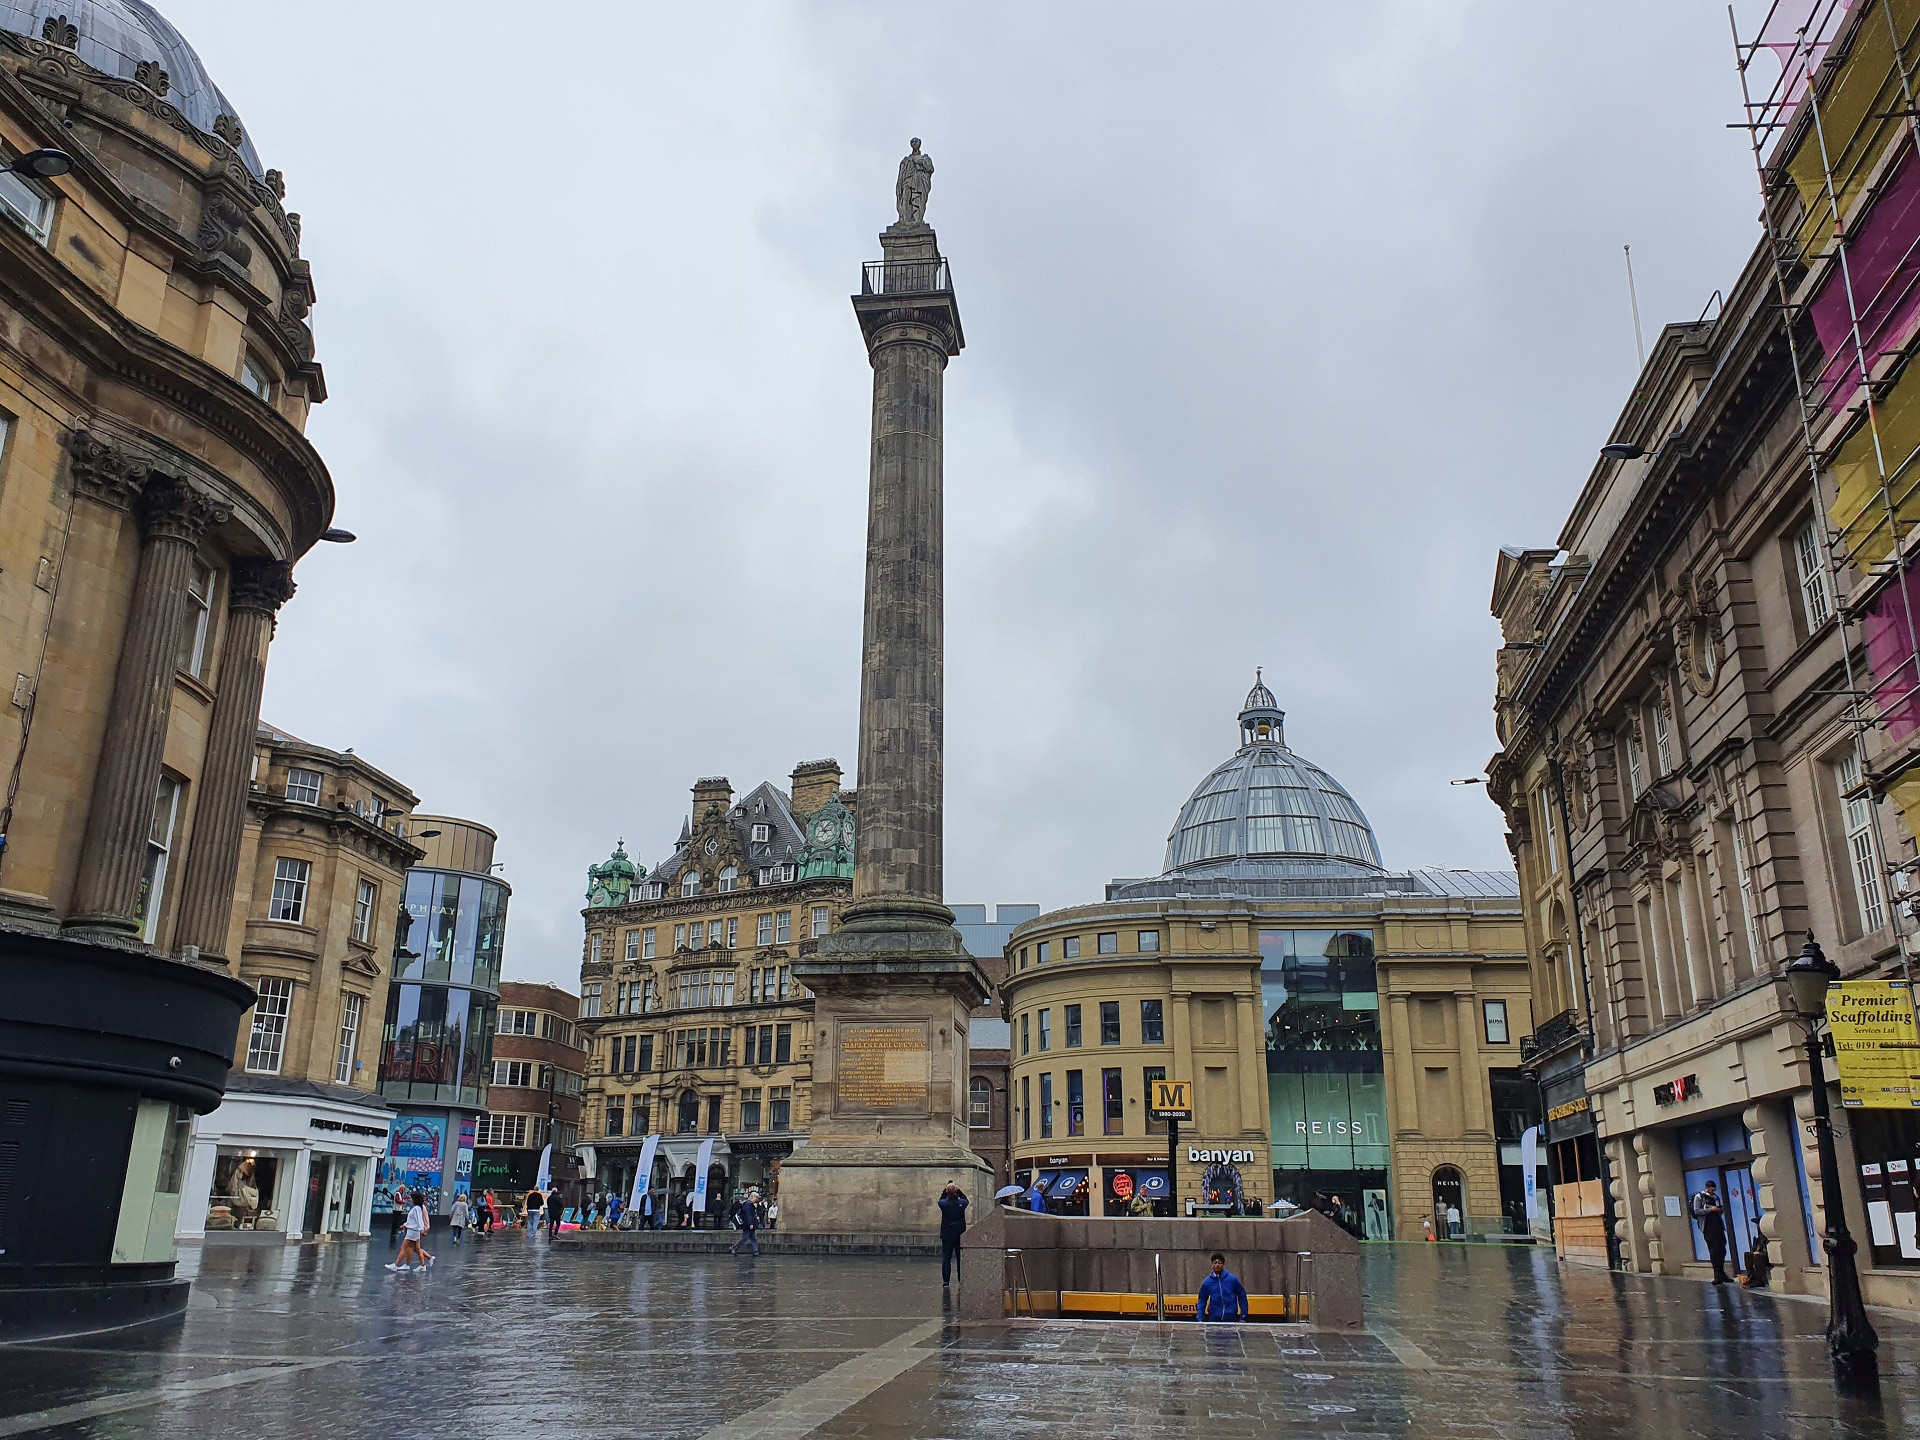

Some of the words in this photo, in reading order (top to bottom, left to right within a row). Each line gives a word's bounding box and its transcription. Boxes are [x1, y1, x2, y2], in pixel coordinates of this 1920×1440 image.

[1841, 994, 1899, 1006] Premier
[1831, 1010, 1912, 1025] Scaffolding
[1838, 1041, 1853, 1049] Tel:
[1856, 1041, 1875, 1049] 0191
[1159, 1084, 1185, 1107] M
[1295, 1121, 1363, 1134] REISS
[738, 1142, 788, 1150] WATERSTONES
[1049, 1156, 1068, 1165] banyan
[1188, 1146, 1254, 1165] banyan
[458, 1160, 471, 1172] AYE
